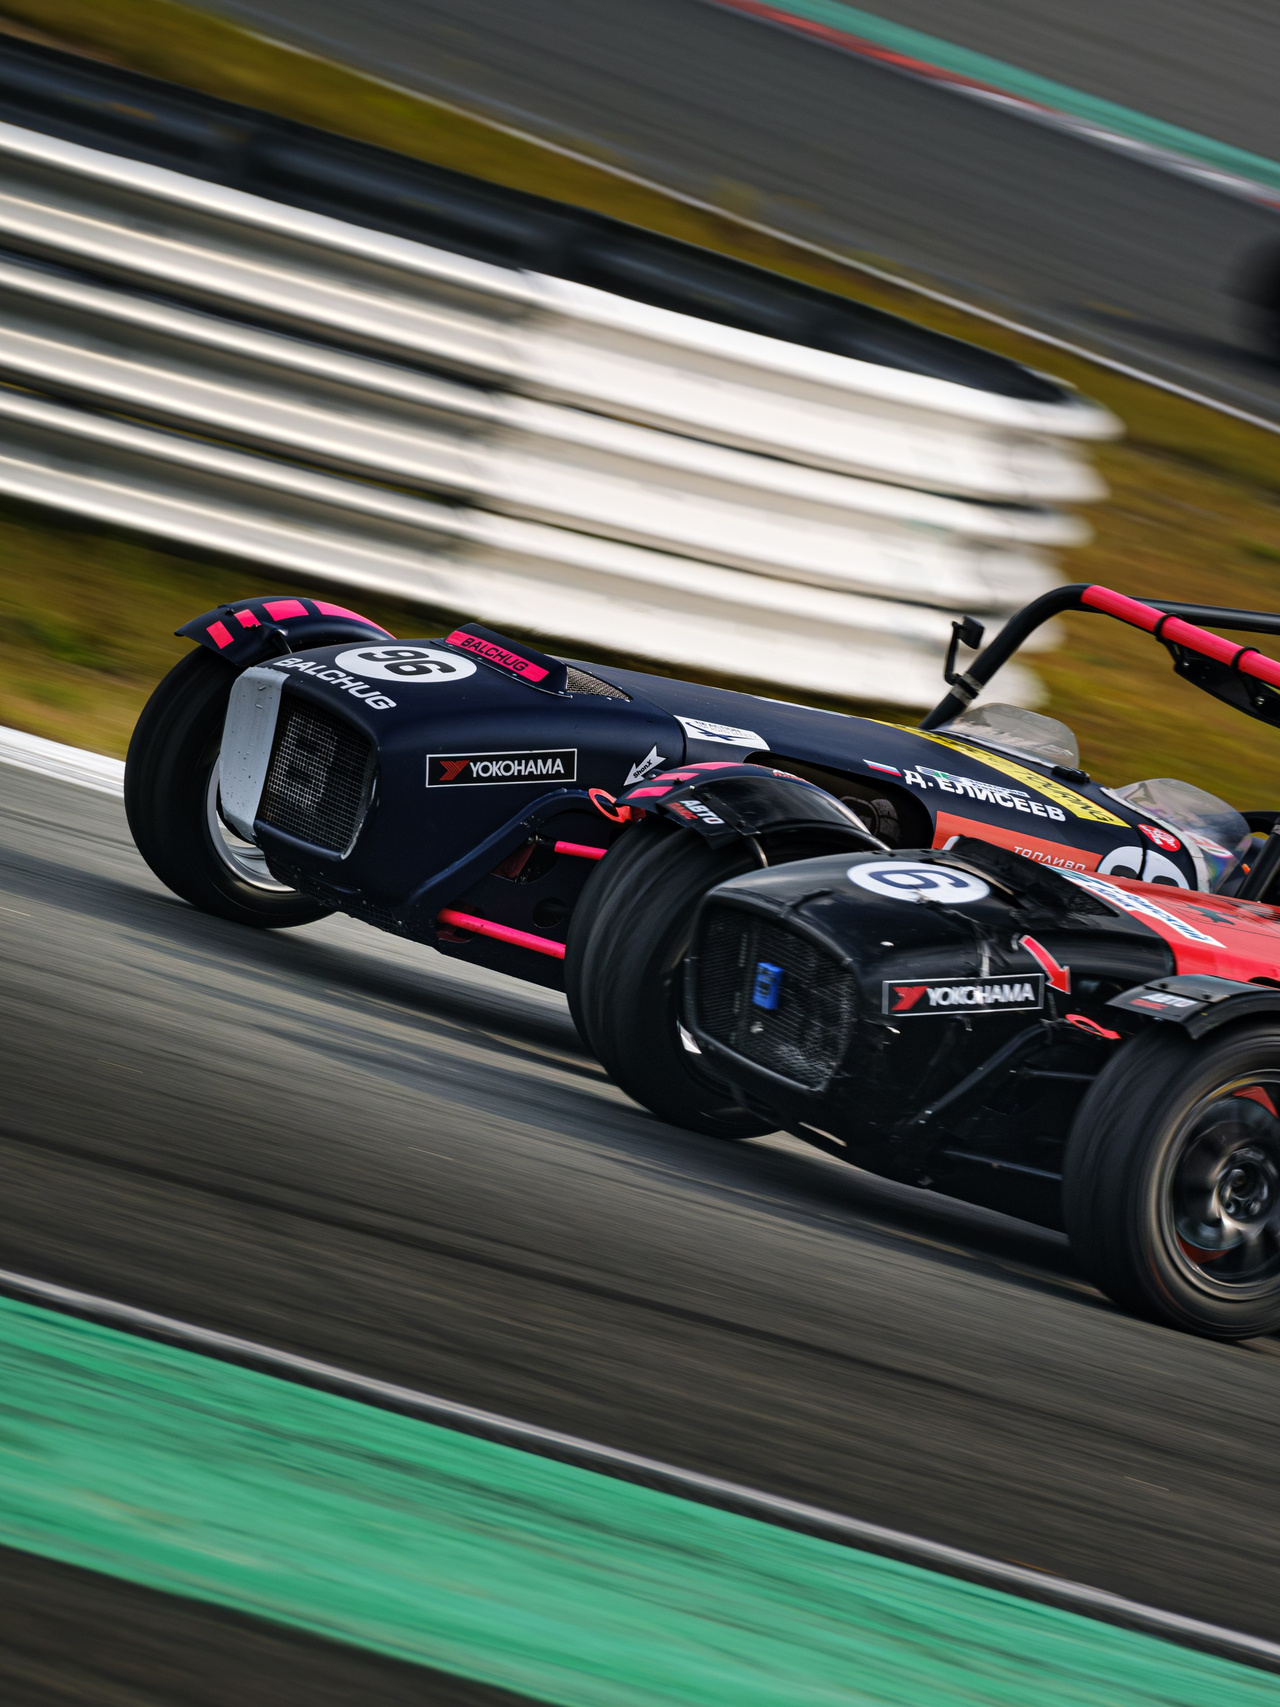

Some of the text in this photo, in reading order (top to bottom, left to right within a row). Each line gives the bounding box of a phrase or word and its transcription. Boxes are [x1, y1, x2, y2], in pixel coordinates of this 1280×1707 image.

[356, 649, 457, 676] 96
[460, 637, 529, 672] BALCHUG
[272, 657, 397, 710] BALCHUG
[469, 758, 565, 778] YOKOHAMA
[1013, 846, 1087, 871] ТОПЛИВО
[926, 982, 1036, 1007] YOKOHAMA
